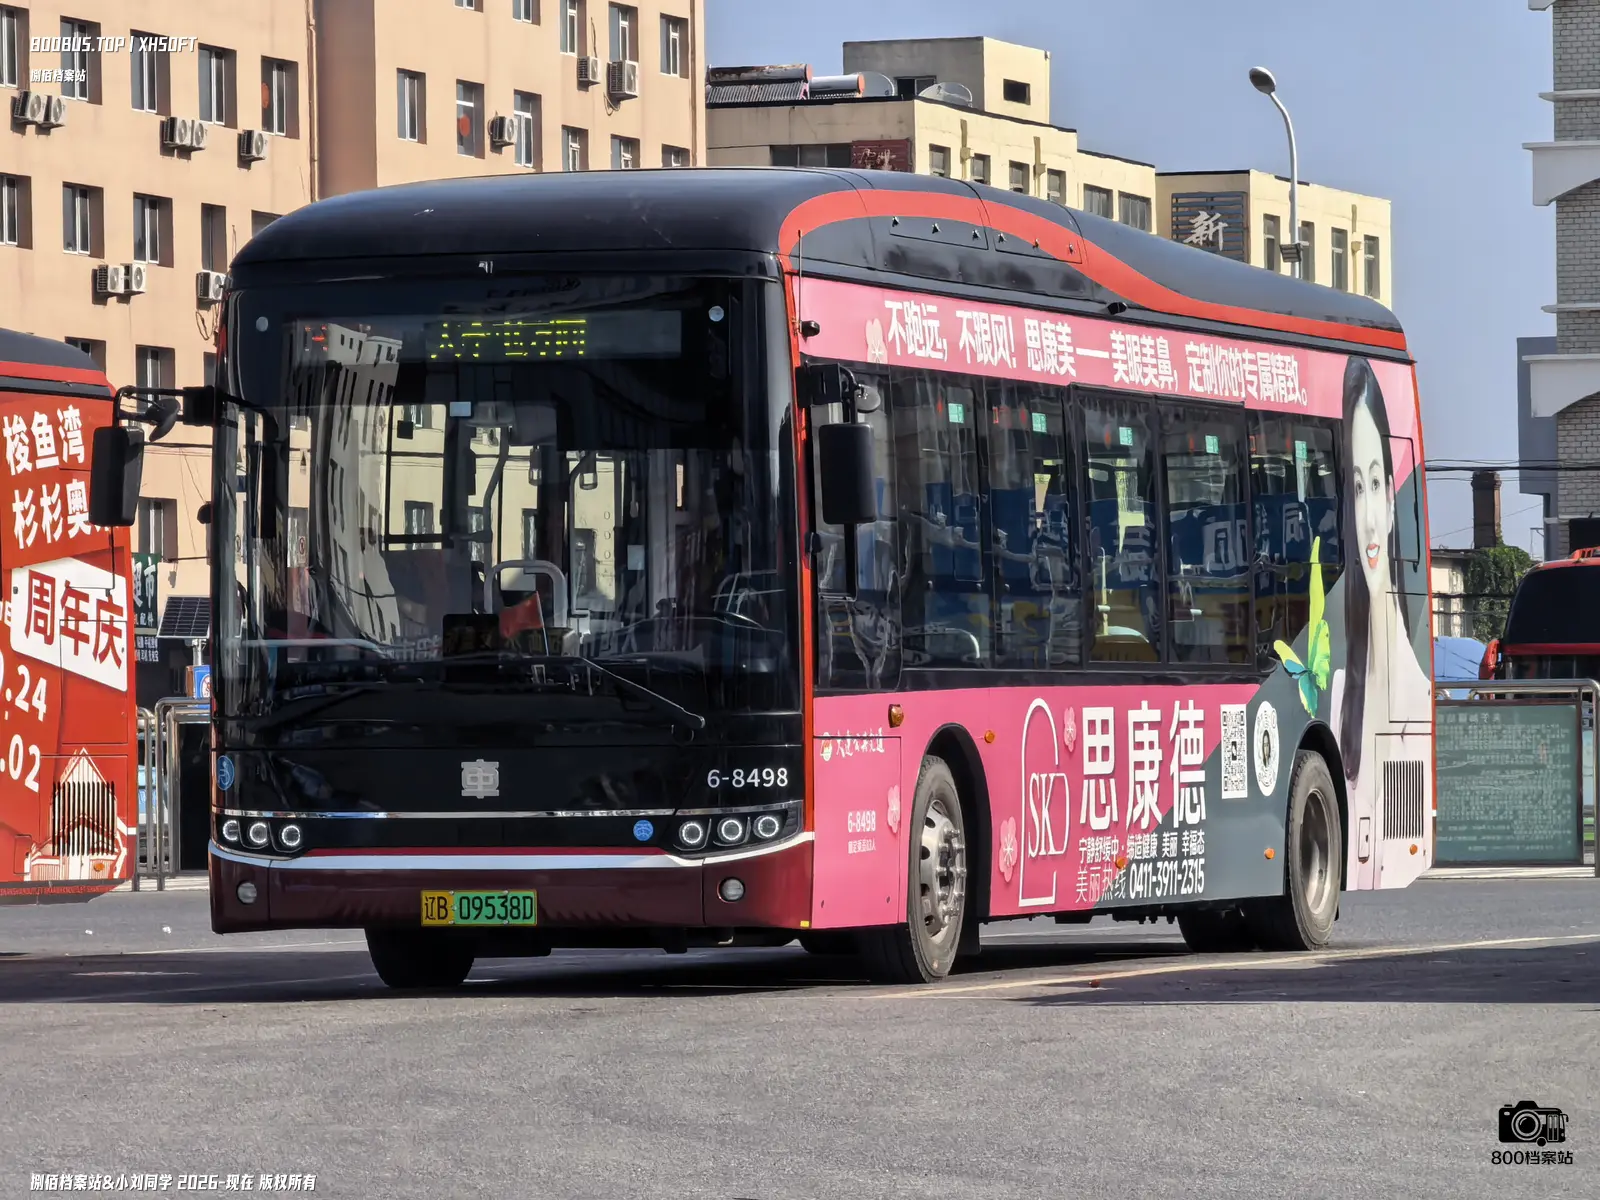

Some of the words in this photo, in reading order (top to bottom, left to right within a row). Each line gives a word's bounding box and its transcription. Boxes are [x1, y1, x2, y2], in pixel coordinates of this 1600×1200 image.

[1183, 210, 1228, 251] 新
[3, 404, 86, 476] 梭鱼湾
[12, 478, 118, 550] 杉杉奥
[24, 568, 124, 670] 周年庆
[707, 767, 788, 788] 6-8498
[1079, 699, 1207, 831] 思康德
[847, 810, 876, 833] 6-8498
[1129, 858, 1205, 900] 0411-3911-2315
